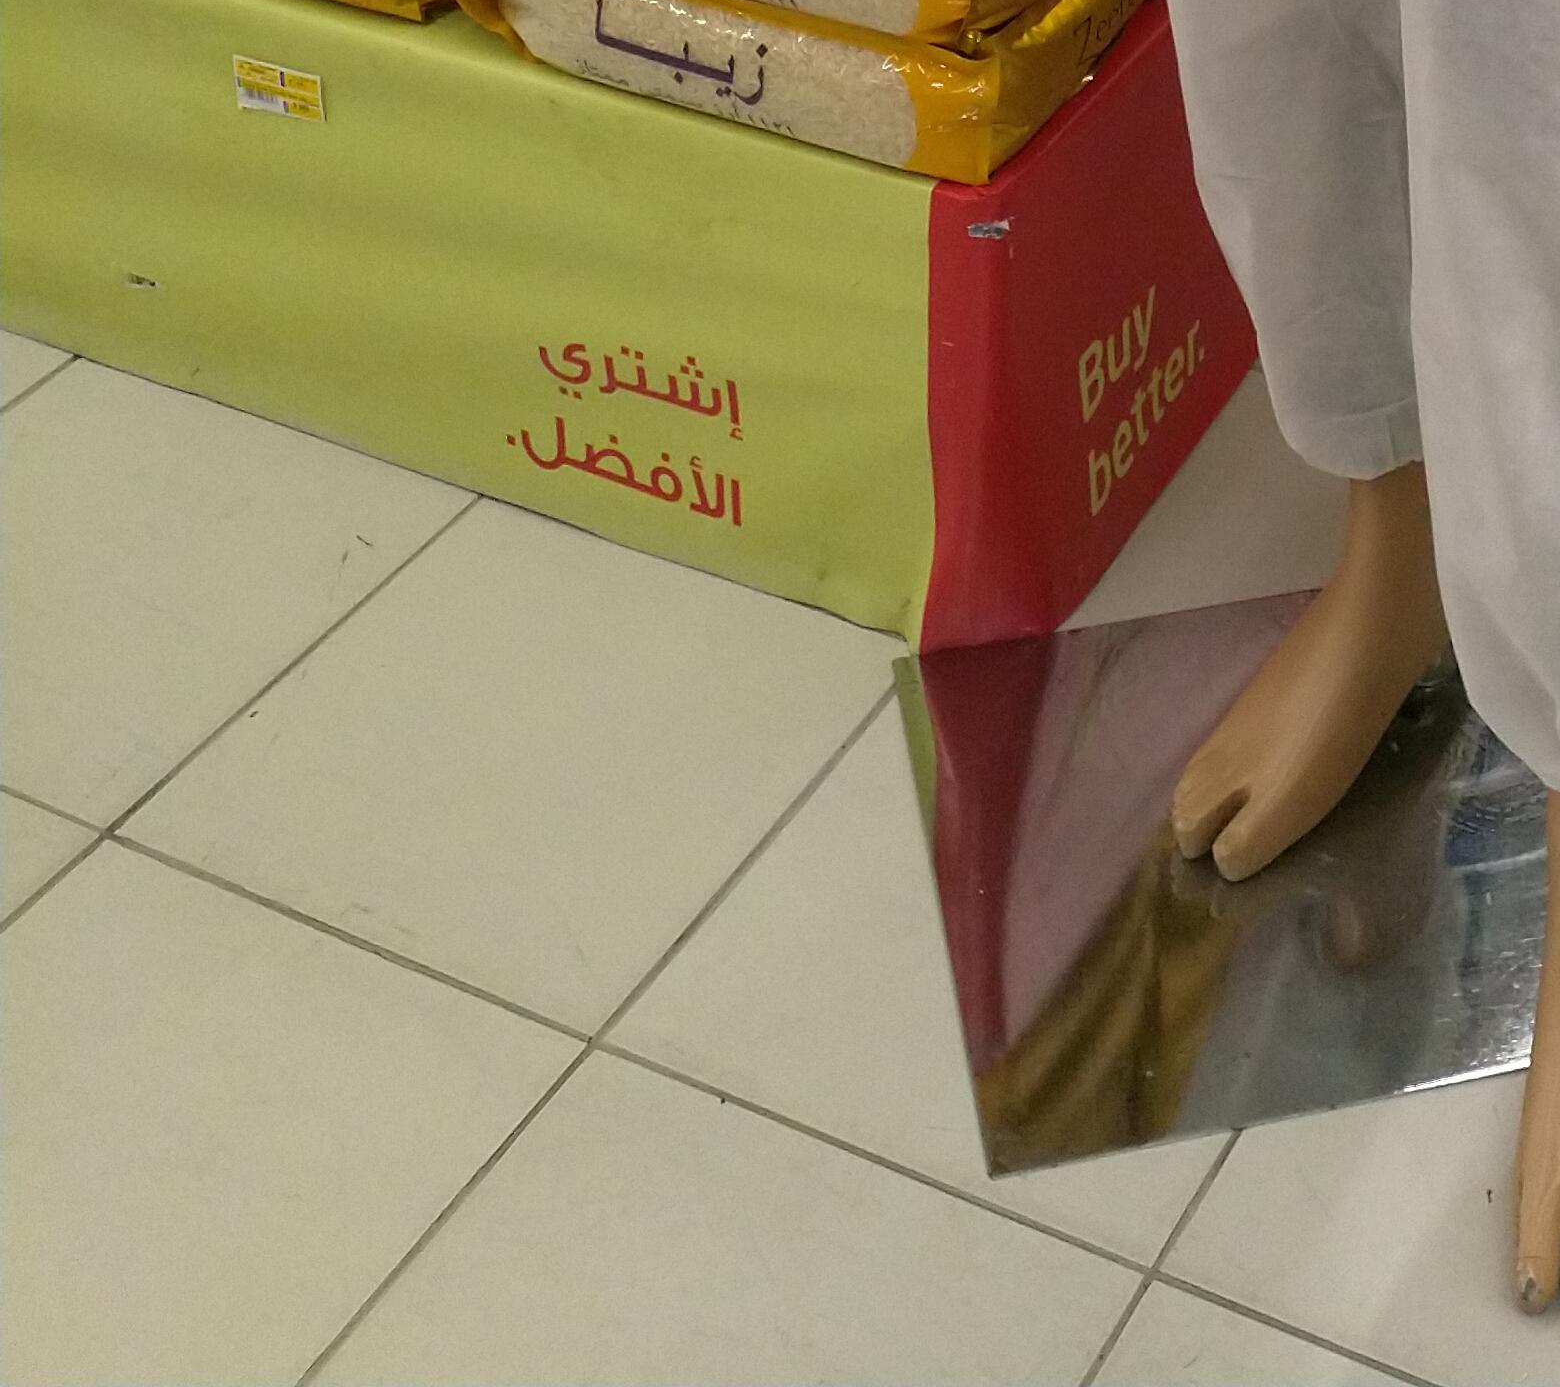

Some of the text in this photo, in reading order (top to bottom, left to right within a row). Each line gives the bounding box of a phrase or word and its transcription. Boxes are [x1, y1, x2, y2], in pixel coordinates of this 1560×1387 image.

[537, 339, 744, 441] إشتري
[1076, 284, 1159, 422] Buy
[1087, 319, 1204, 517] better.
